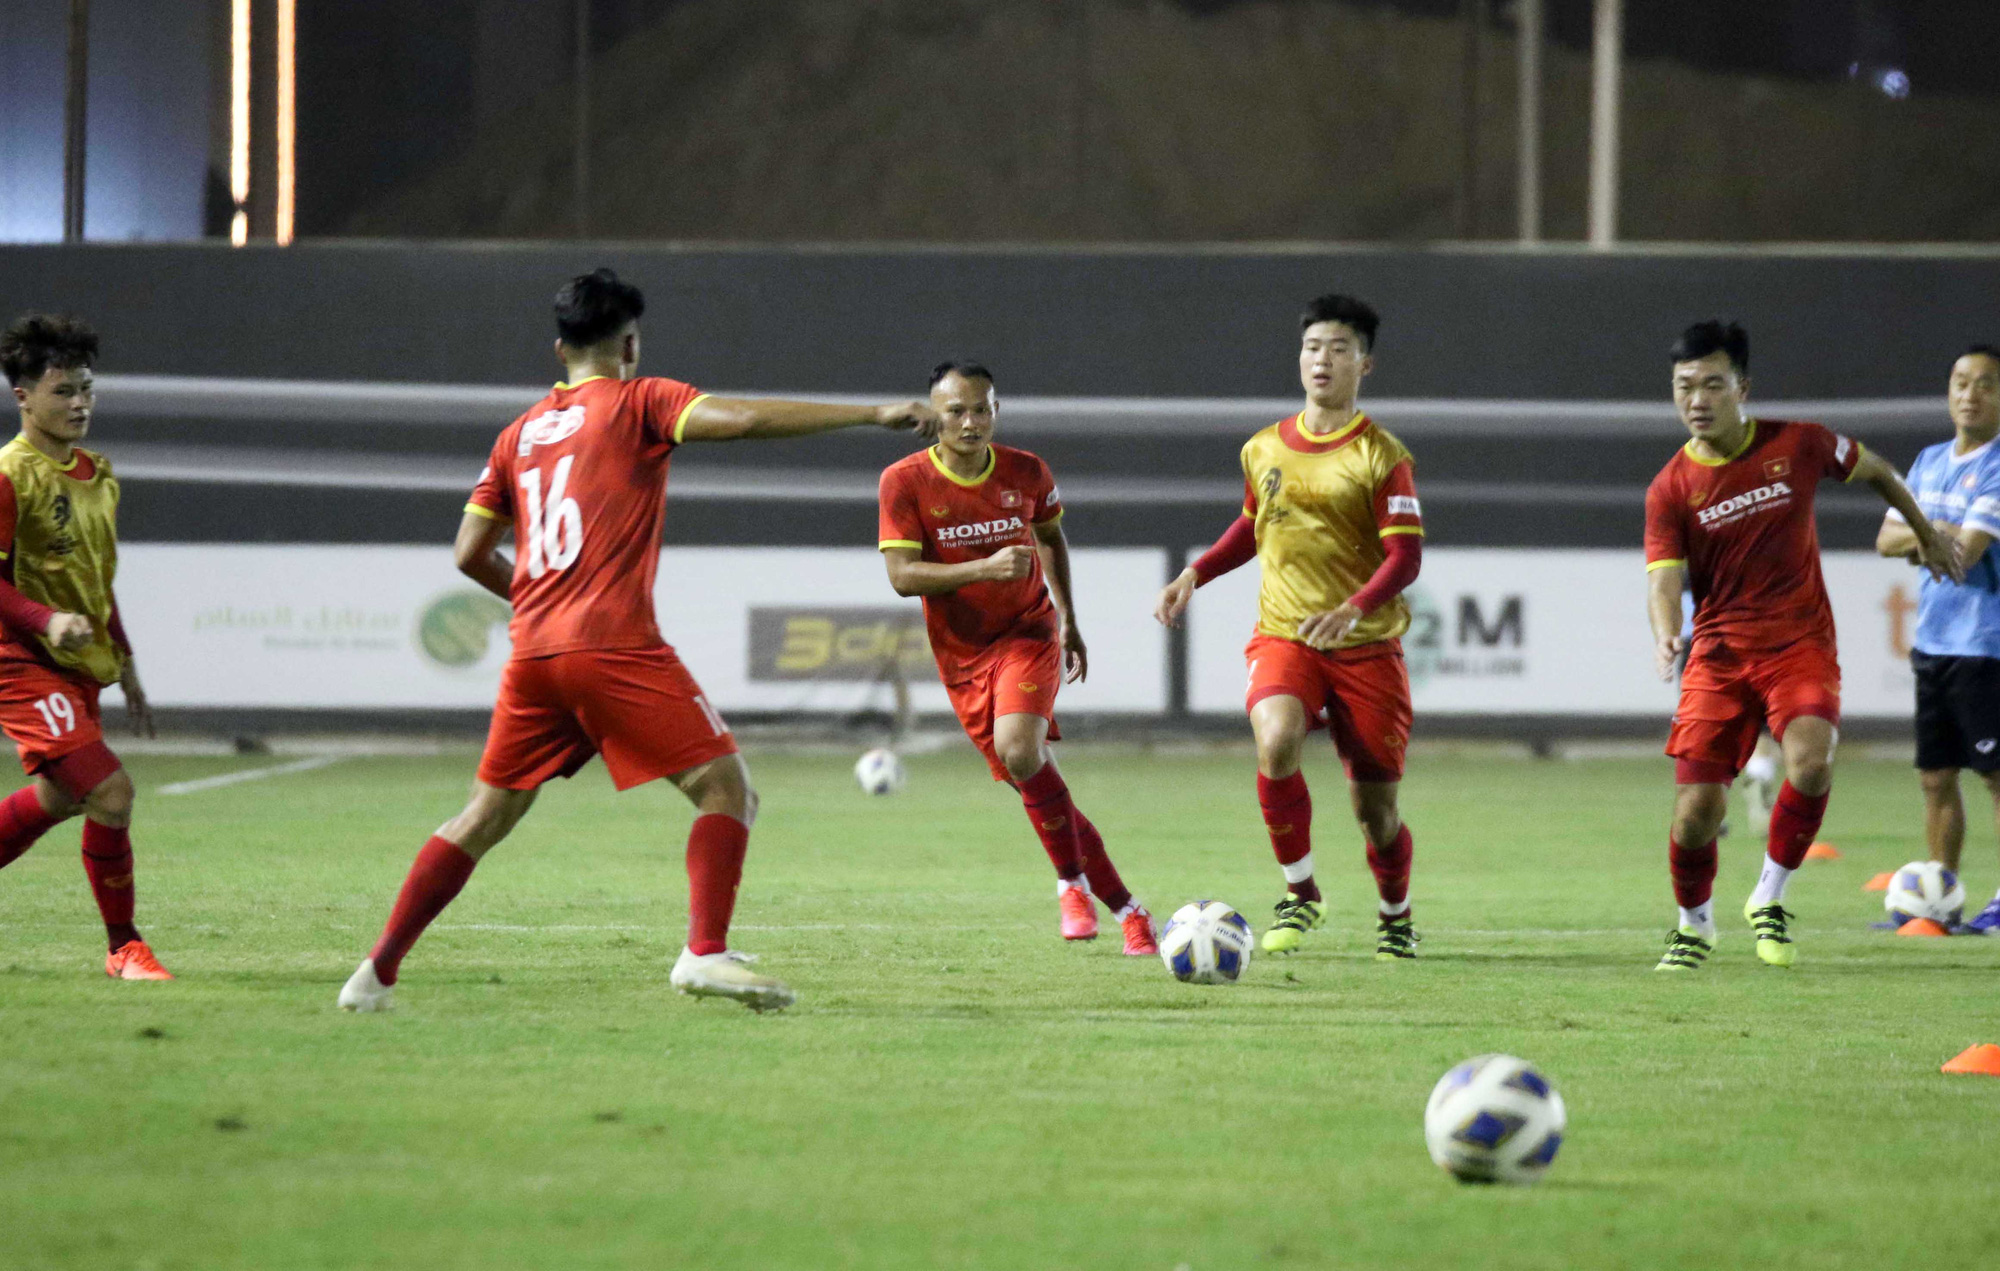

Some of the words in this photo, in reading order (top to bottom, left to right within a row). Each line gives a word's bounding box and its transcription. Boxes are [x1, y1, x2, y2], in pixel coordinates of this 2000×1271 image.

[519, 455, 583, 579] 16
[1696, 481, 1792, 525] HONDA
[937, 516, 1024, 540] HONDA
[942, 540, 957, 548] The
[957, 537, 982, 547] Power
[984, 535, 993, 543] of
[33, 692, 75, 737] 19
